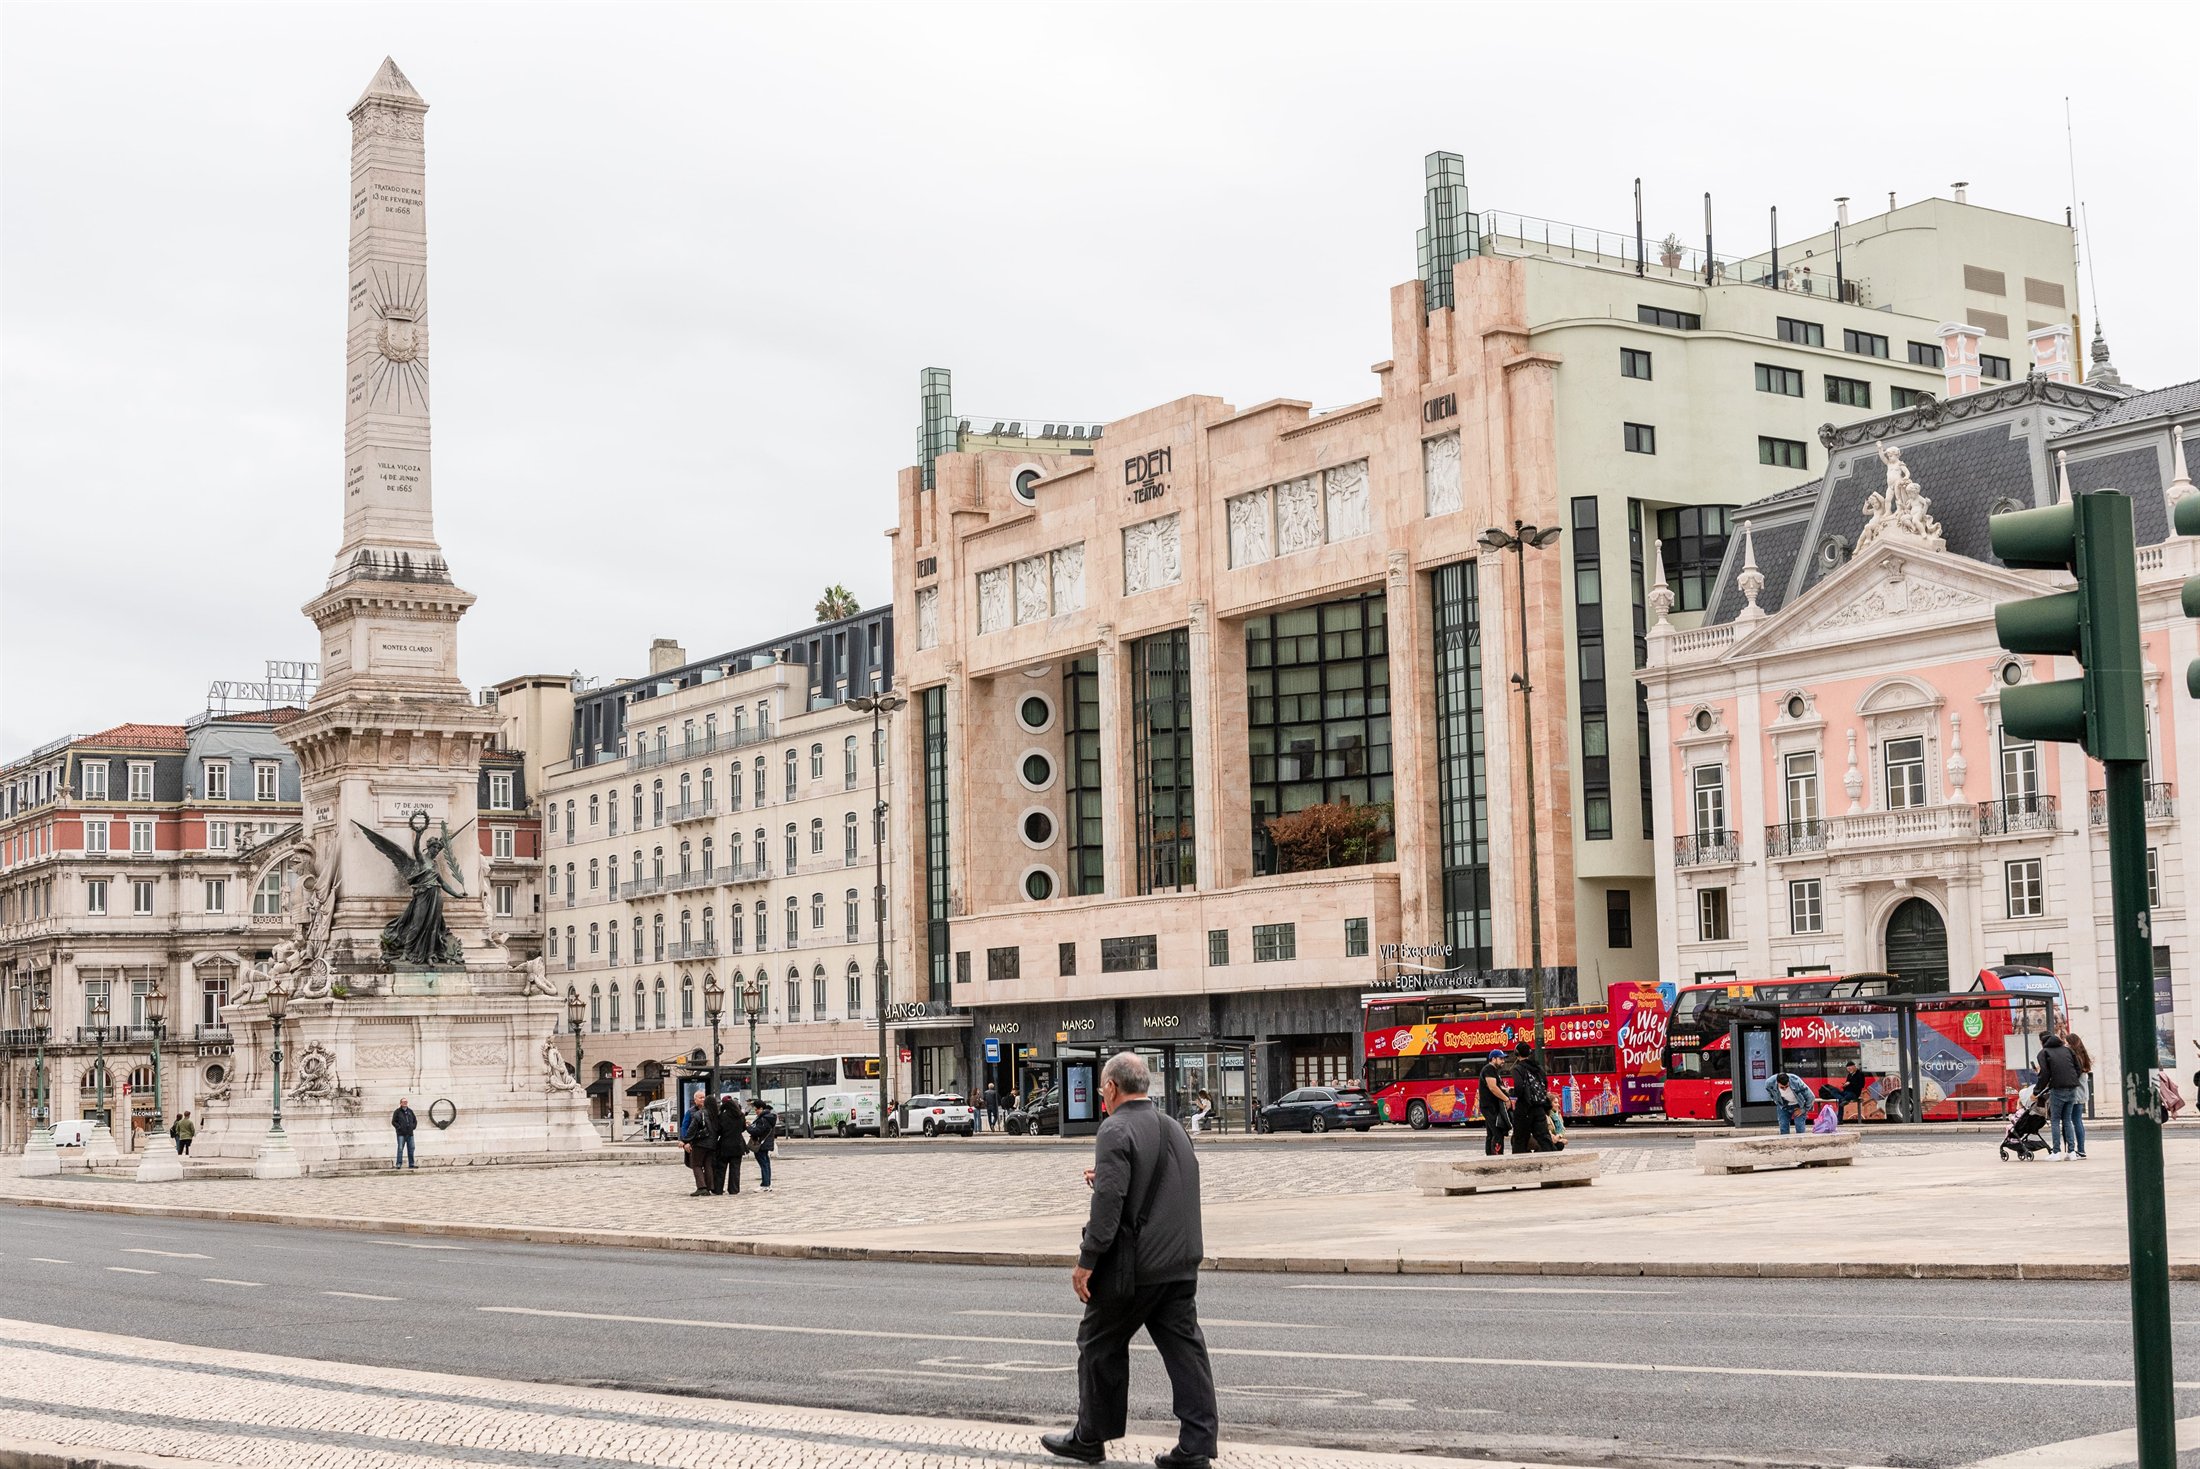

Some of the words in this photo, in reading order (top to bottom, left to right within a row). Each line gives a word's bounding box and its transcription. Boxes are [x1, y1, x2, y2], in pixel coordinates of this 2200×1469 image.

[374, 184, 400, 192] TRATADO
[390, 196, 423, 207] FEVEREIRO
[395, 206, 411, 214] 1668
[1424, 392, 1457, 423] CINEMA
[397, 464, 421, 472] VIÇOZA
[1125, 444, 1171, 485] EDEN
[397, 484, 412, 492] 1665
[1133, 483, 1164, 504] TEATRO
[916, 556, 937, 579] TEATRO
[207, 680, 308, 702] AVENIDA
[1379, 943, 1398, 960] VIP
[1400, 941, 1453, 960] Executive
[1423, 976, 1478, 987] APARTHOTEL
[1062, 1019, 1096, 1031] MANGO
[1143, 1016, 1180, 1028] MANGO
[1637, 1009, 1658, 1031] We
[989, 1023, 1020, 1034] MANGO
[1518, 1026, 1556, 1044] Porgal
[1781, 1021, 1804, 1040] sbon
[1807, 1020, 1874, 1044] Sightseeing
[1617, 1025, 1656, 1049] Show
[1221, 1058, 1244, 1066] ANGO
